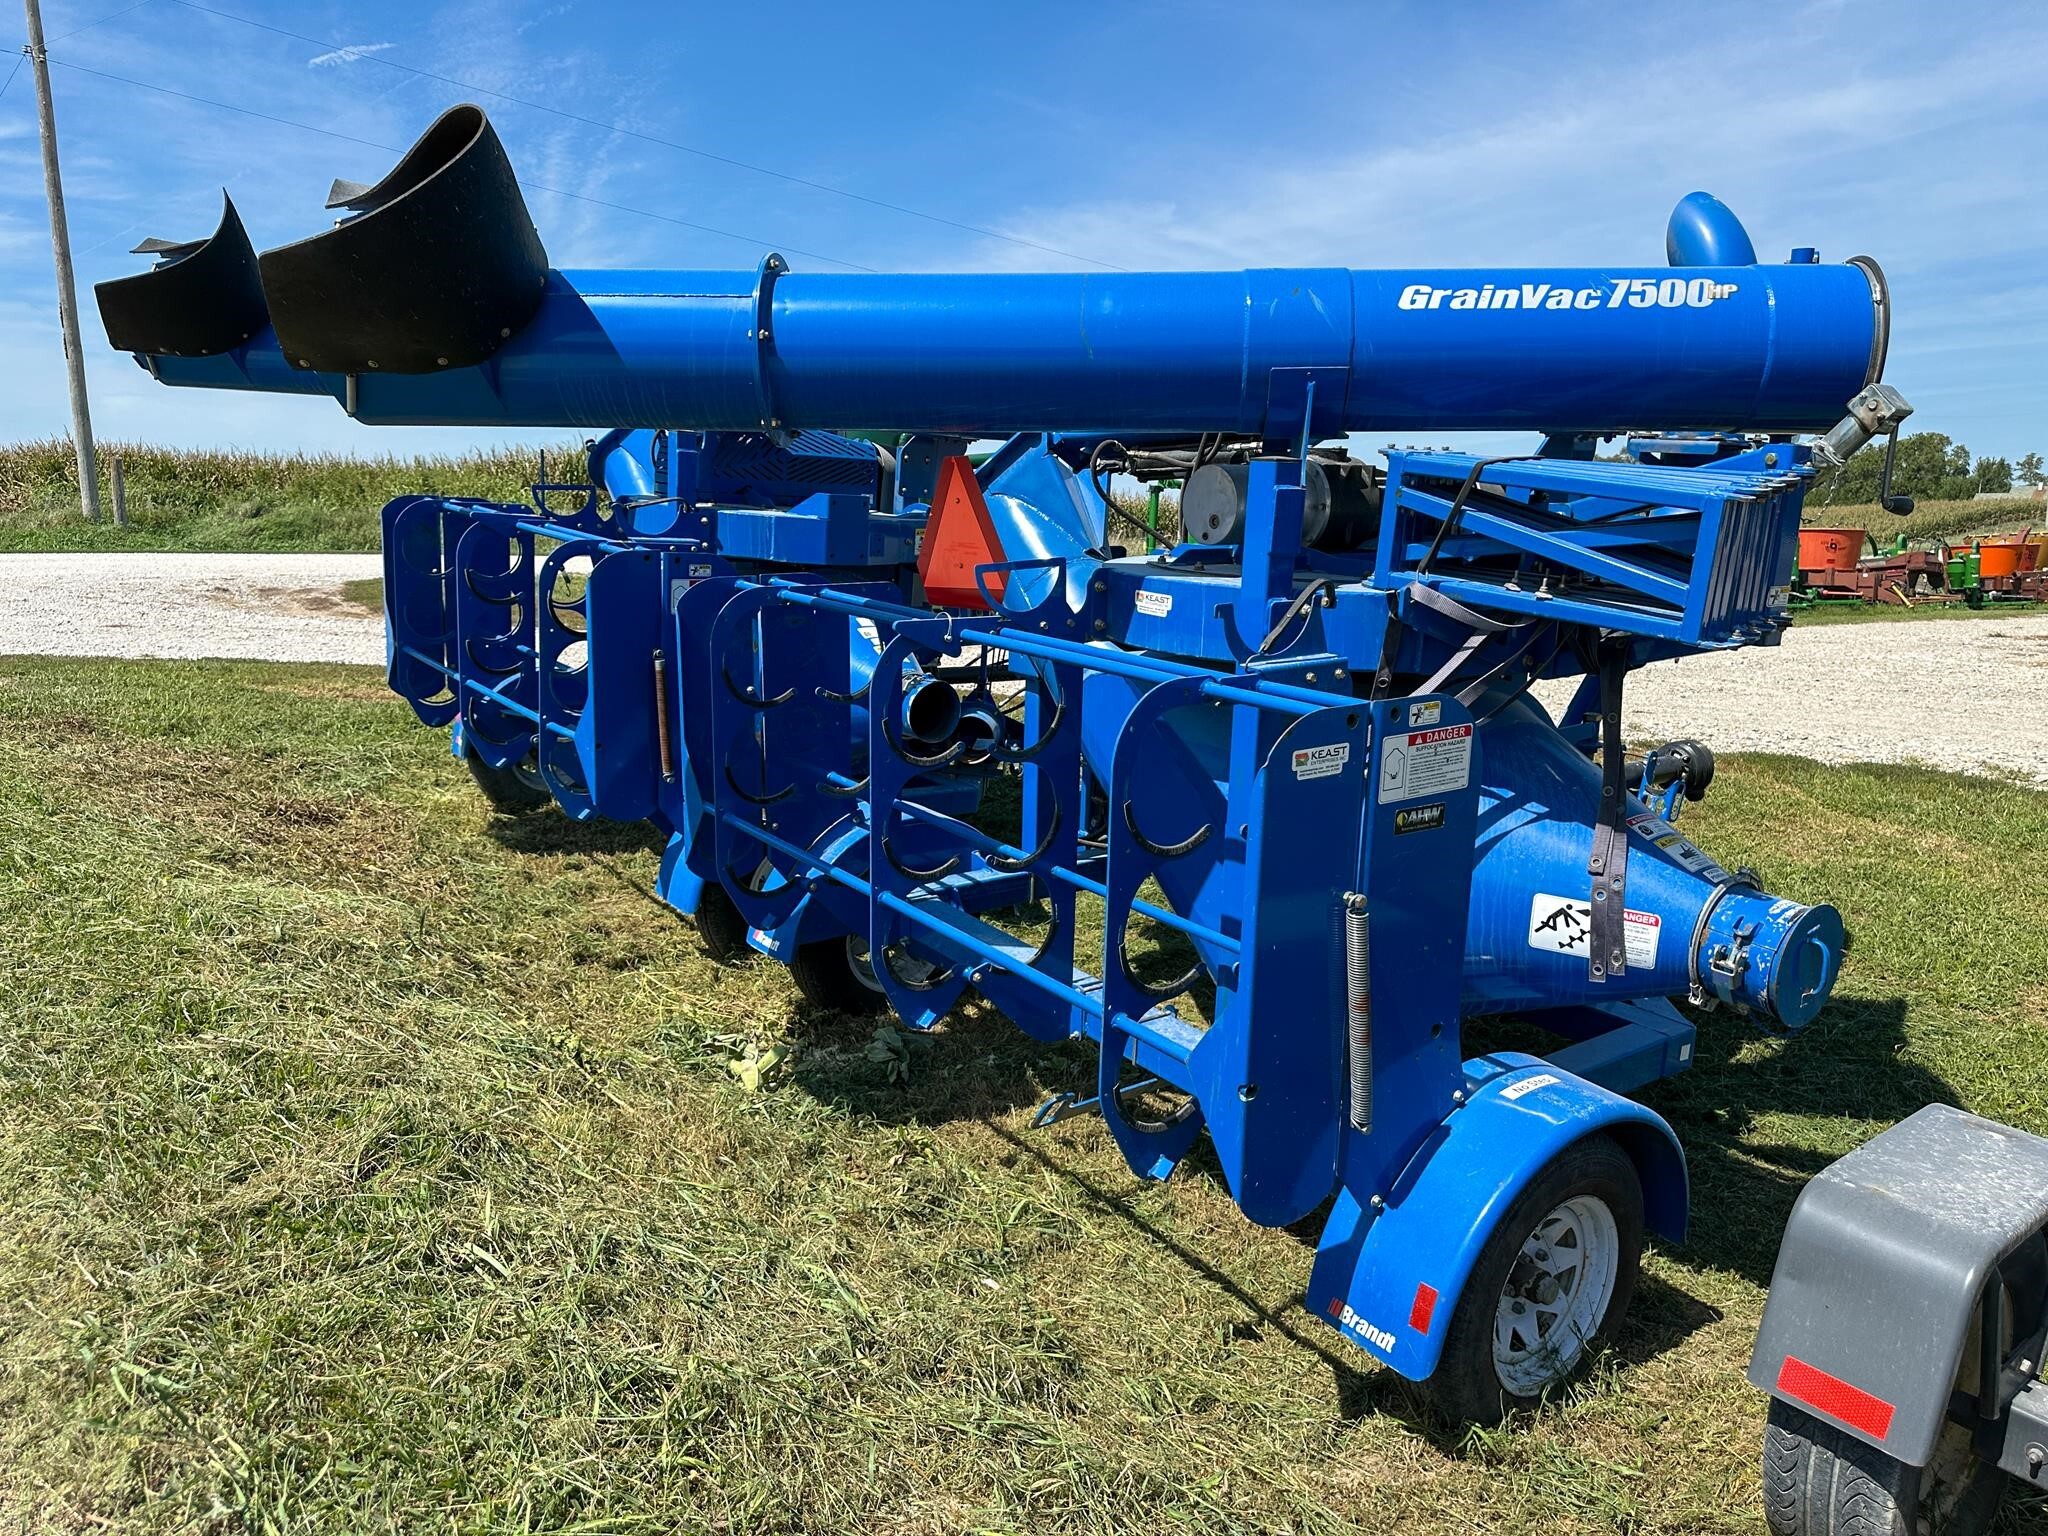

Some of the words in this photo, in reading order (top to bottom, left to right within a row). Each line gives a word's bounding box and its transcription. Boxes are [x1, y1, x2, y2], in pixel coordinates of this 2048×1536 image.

[1397, 284, 1602, 310] GrainVac
[1606, 278, 1714, 308] 7500
[1708, 284, 1738, 299] HP
[1145, 594, 1170, 604] KEAST
[1426, 727, 1466, 742] DANGER
[1311, 745, 1347, 760] KEAST
[1415, 742, 1447, 752] SUFFOCATION
[1447, 738, 1466, 747] HAZARD
[1623, 911, 1656, 925] ANGER
[1339, 1304, 1396, 1354] Brandt
